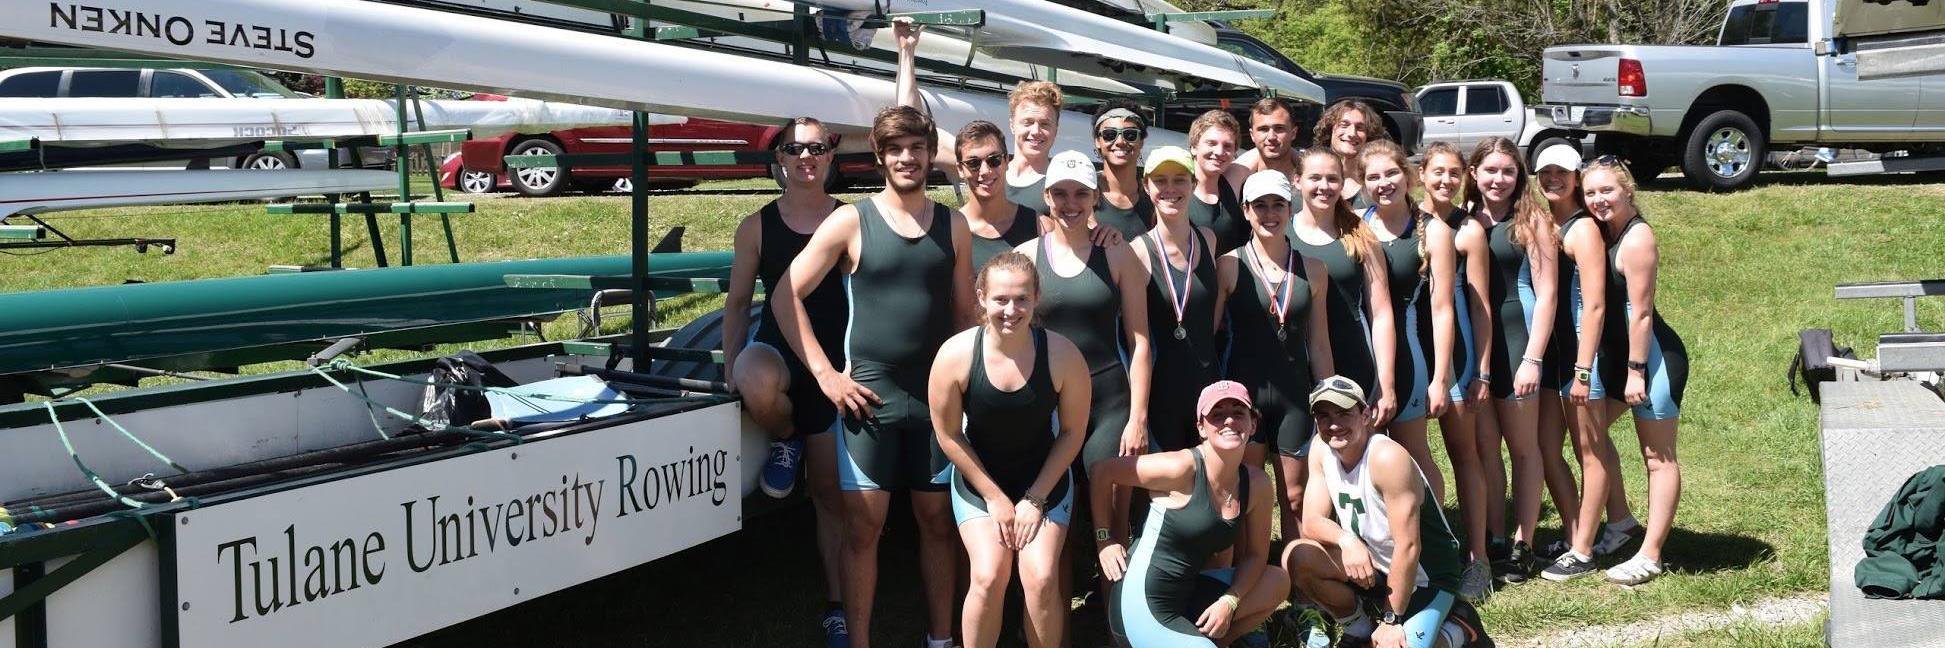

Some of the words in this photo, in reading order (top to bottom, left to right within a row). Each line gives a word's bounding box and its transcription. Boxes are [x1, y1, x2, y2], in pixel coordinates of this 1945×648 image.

[50, 2, 194, 46] ONKEN
[205, 19, 315, 59] STEVE
[217, 523, 386, 624] Tulane
[400, 472, 605, 573] University
[615, 445, 728, 518] Rowing
